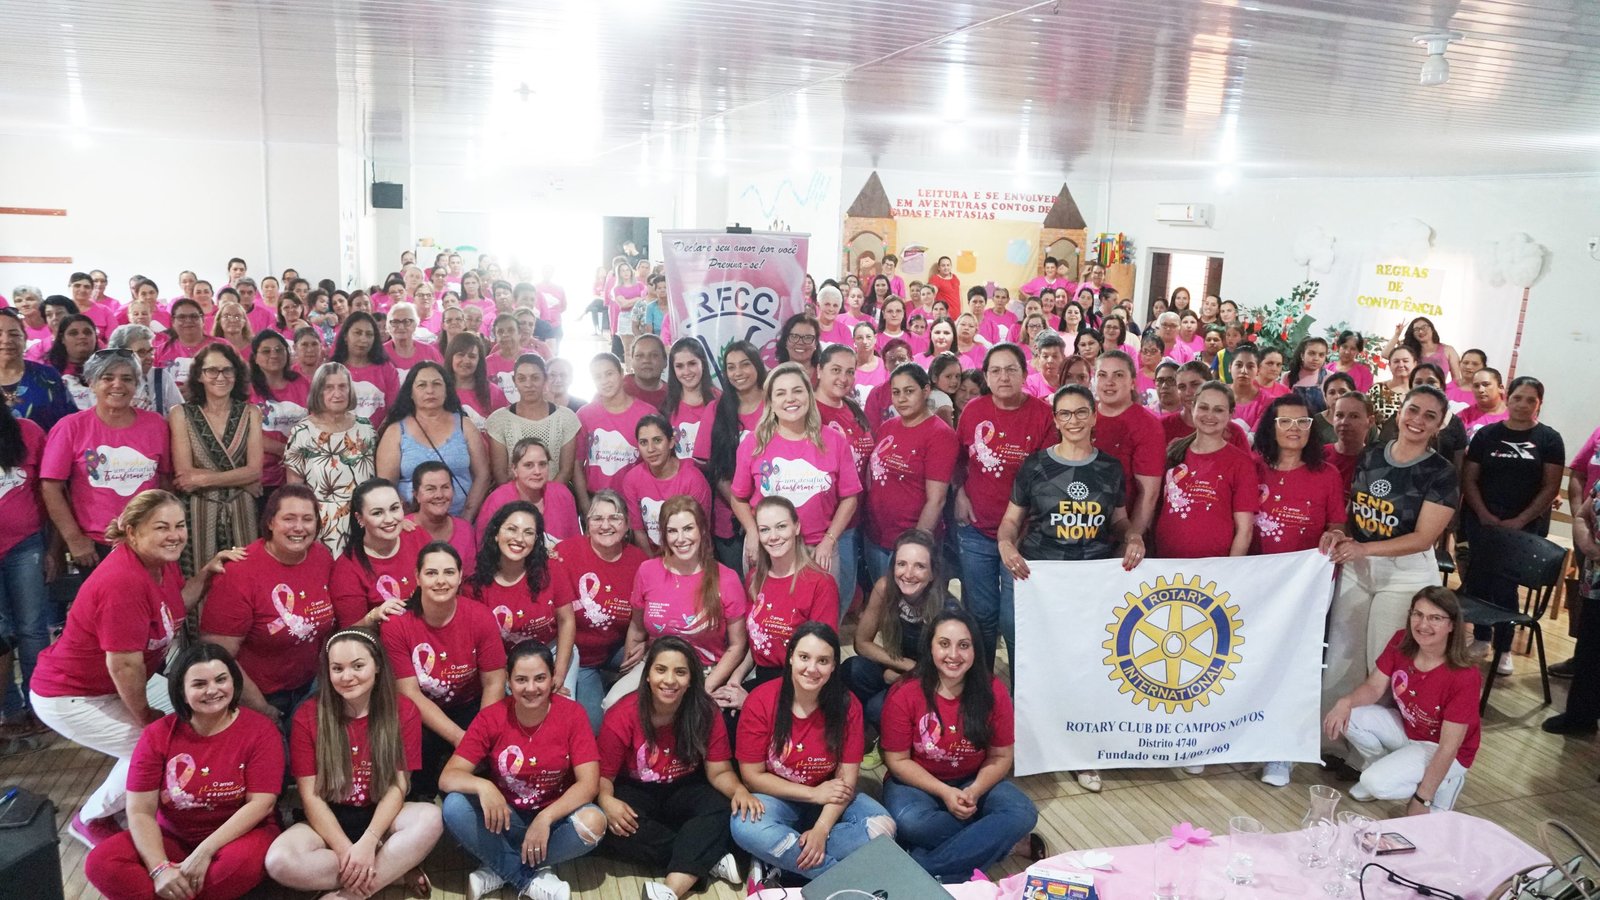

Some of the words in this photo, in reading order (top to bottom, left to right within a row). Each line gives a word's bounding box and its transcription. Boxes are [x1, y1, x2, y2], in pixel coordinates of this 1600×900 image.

[918, 189, 968, 200] LEITURA
[974, 192, 981, 200] E
[986, 192, 1000, 200] SE
[1004, 192, 1058, 204] ENVOLVER
[896, 199, 912, 208] EM
[918, 200, 987, 210] AVENTURAS
[992, 202, 1035, 212] CONTOS
[1038, 206, 1052, 214] DE
[933, 208, 996, 220] FANTASIAS
[674, 241, 712, 252] Declare
[759, 246, 775, 255] por
[778, 244, 798, 254] você
[708, 258, 766, 270] Previna-se!
[1376, 264, 1429, 278] REGRAS
[1388, 281, 1404, 292] DE
[1357, 296, 1443, 316] CONVIVÊNCIA
[1059, 501, 1101, 515] END
[1356, 492, 1394, 514] END
[1050, 512, 1106, 527] POLIO
[1352, 501, 1399, 527] POLIO
[1056, 525, 1098, 539] NOW
[1356, 514, 1392, 537] NOW
[1149, 589, 1207, 606] ROTARY
[1123, 665, 1223, 700] INTERNATIONAL
[1066, 721, 1116, 733] ROTARY
[1118, 722, 1152, 734] CLUB
[1156, 723, 1172, 734] DE
[1175, 722, 1226, 734] CAMPOS
[1228, 711, 1264, 729] NOVOS
[1138, 738, 1173, 748] Distrito
[1176, 738, 1197, 748] 4740
[1097, 750, 1149, 761] Fundado
[1152, 753, 1169, 761] em
